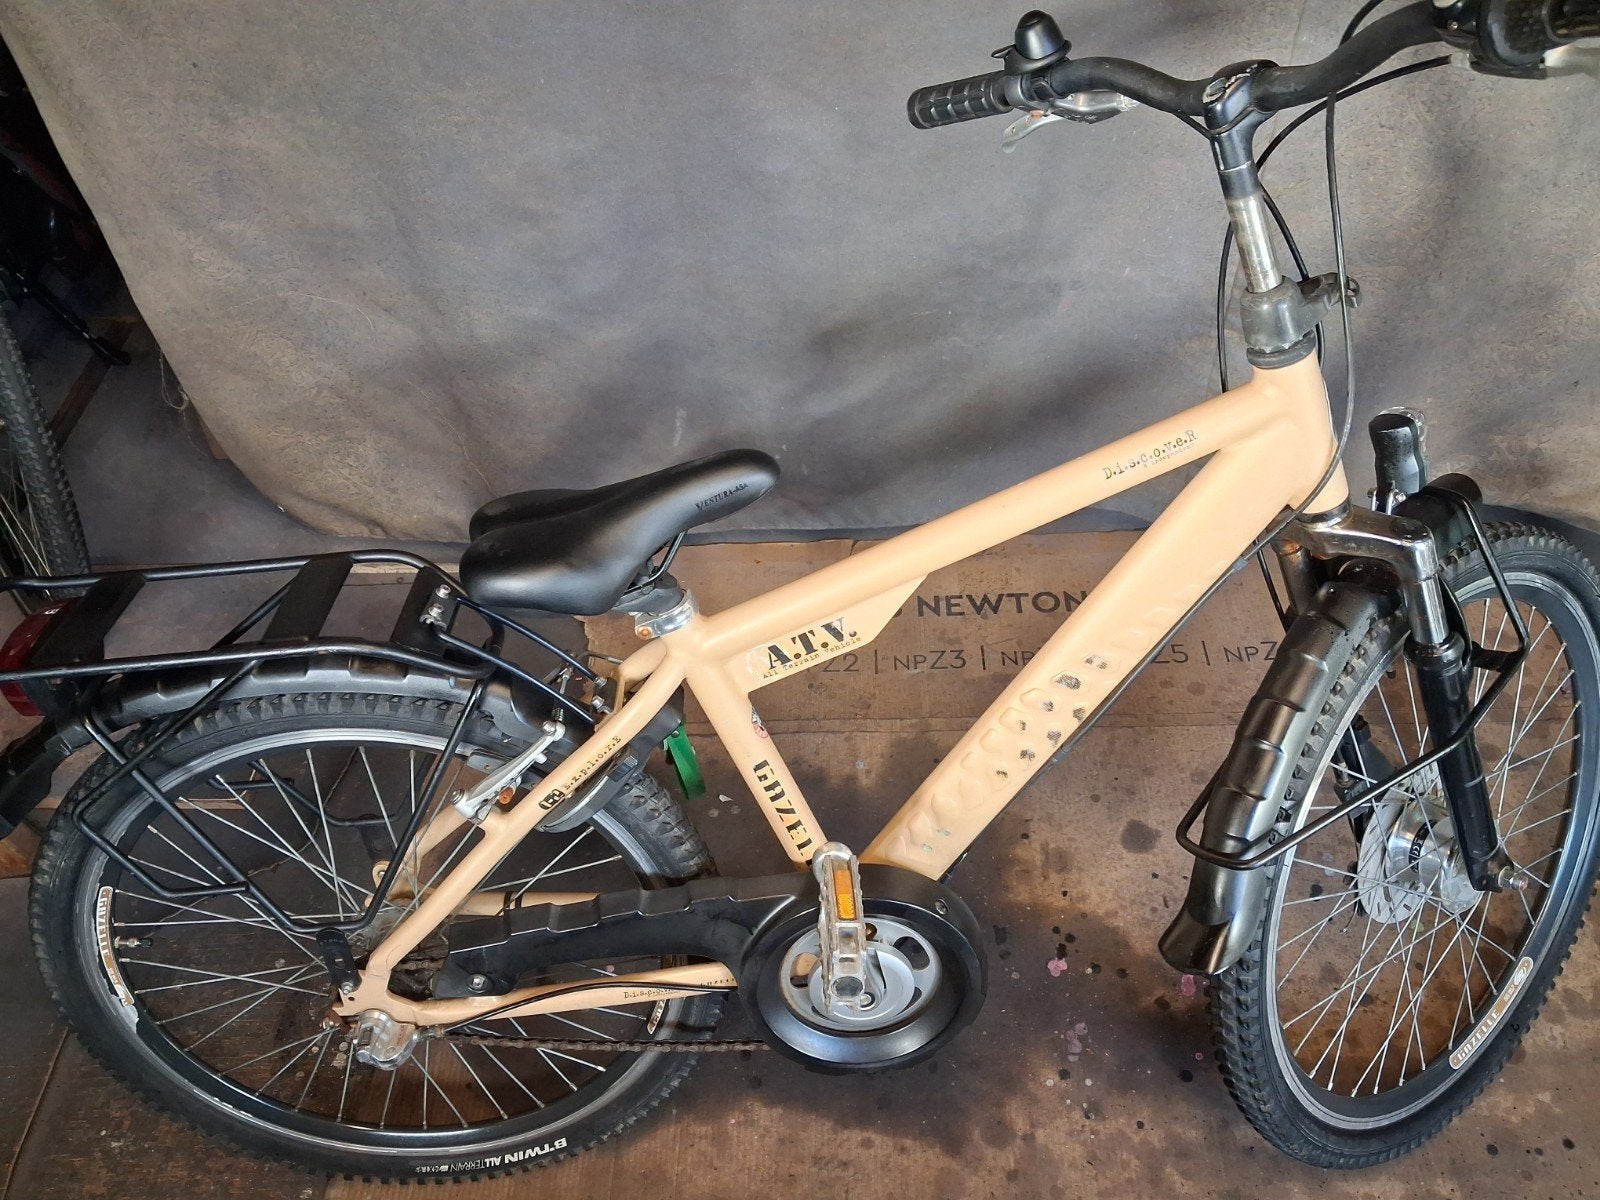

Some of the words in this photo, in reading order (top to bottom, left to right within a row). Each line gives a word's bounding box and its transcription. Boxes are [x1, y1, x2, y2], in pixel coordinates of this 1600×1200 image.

[768, 616, 858, 671] A.T.V.
[893, 650, 967, 671] NPZ3
[1223, 641, 1278, 663] NPZ
[753, 759, 813, 857] GAZEL
[1457, 1009, 1500, 1061] GAZELLE
